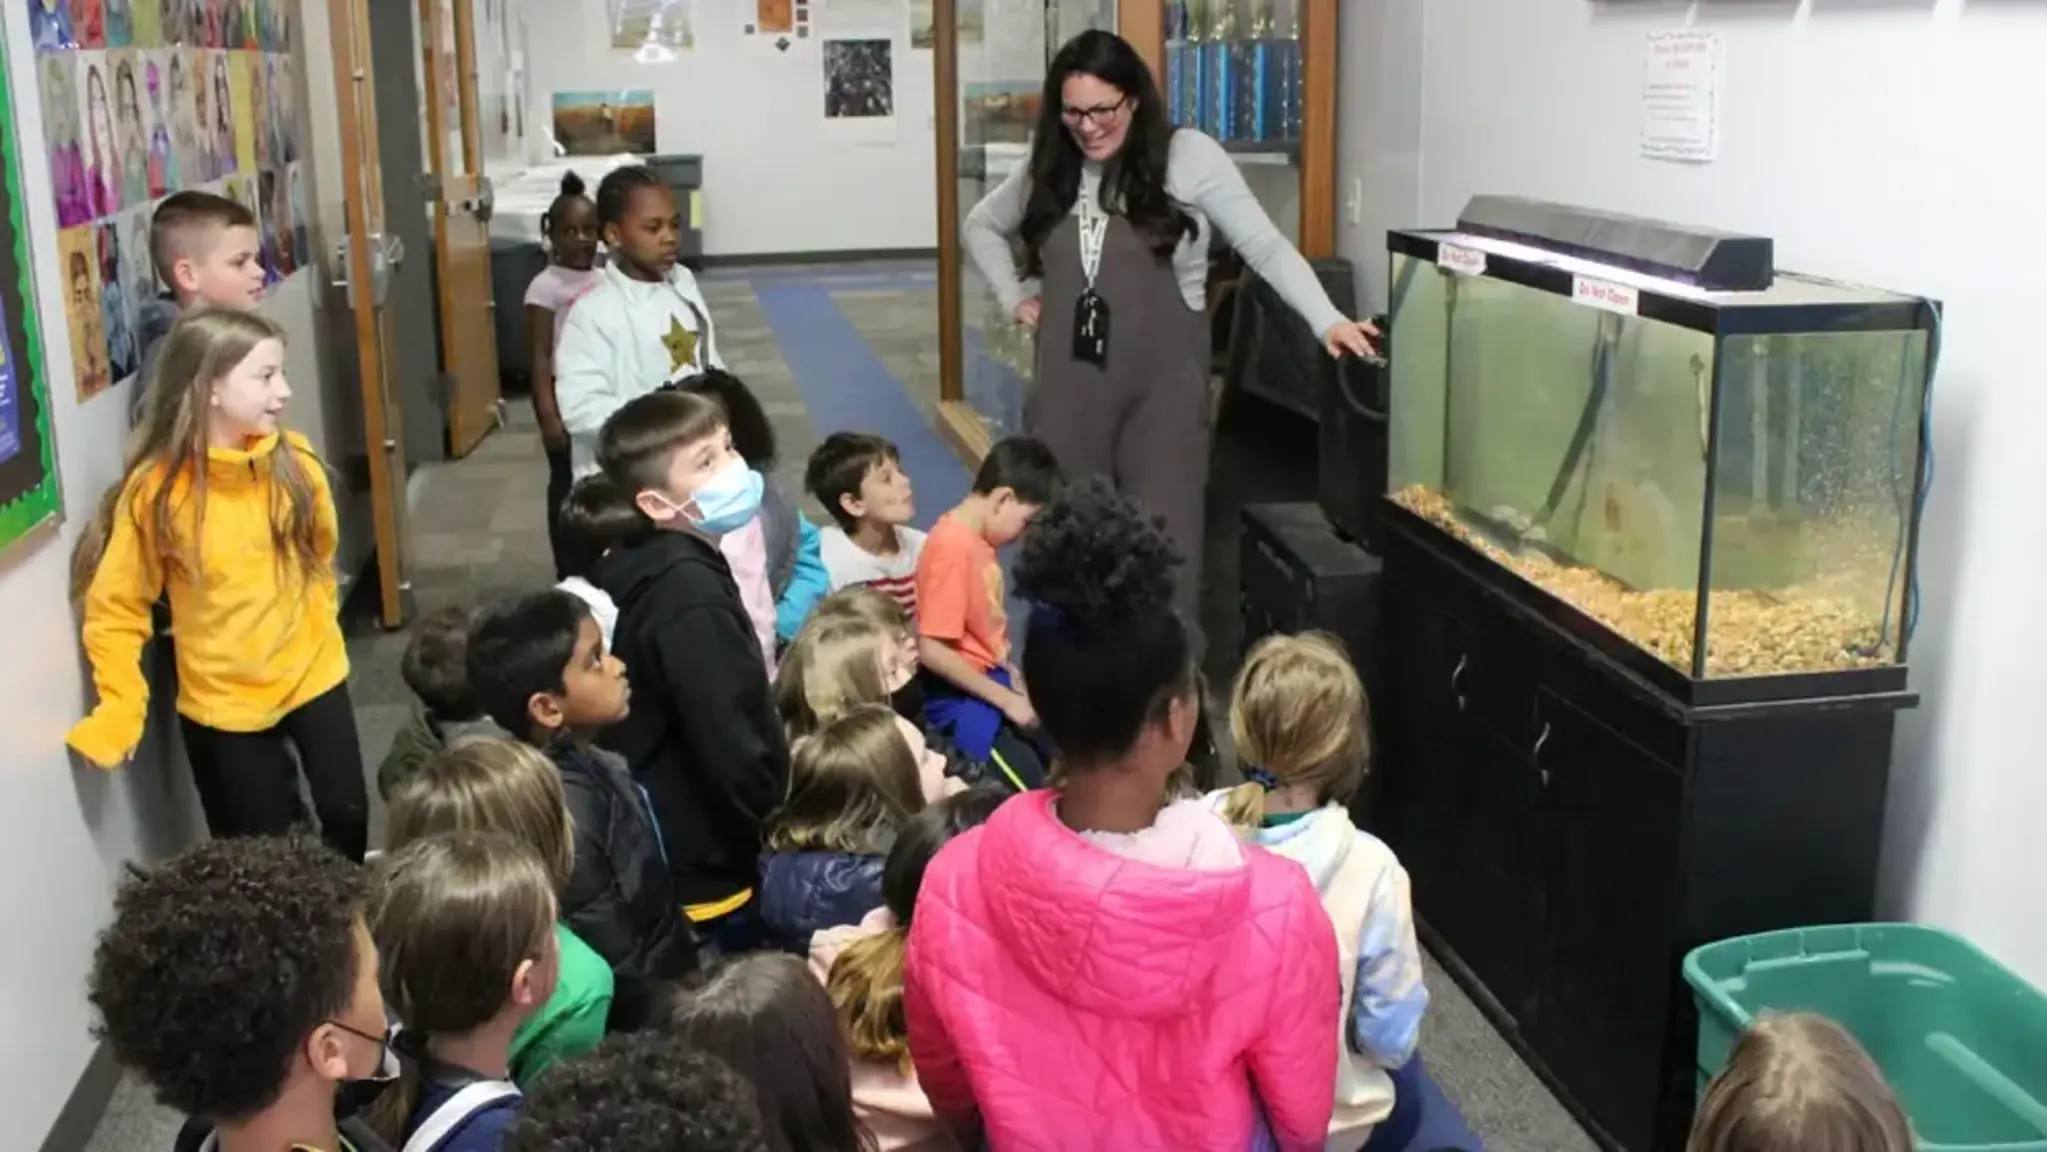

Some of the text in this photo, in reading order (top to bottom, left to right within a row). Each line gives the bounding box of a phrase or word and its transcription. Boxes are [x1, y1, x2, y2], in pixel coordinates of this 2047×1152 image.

[1579, 281, 1629, 305] Do Not Open
